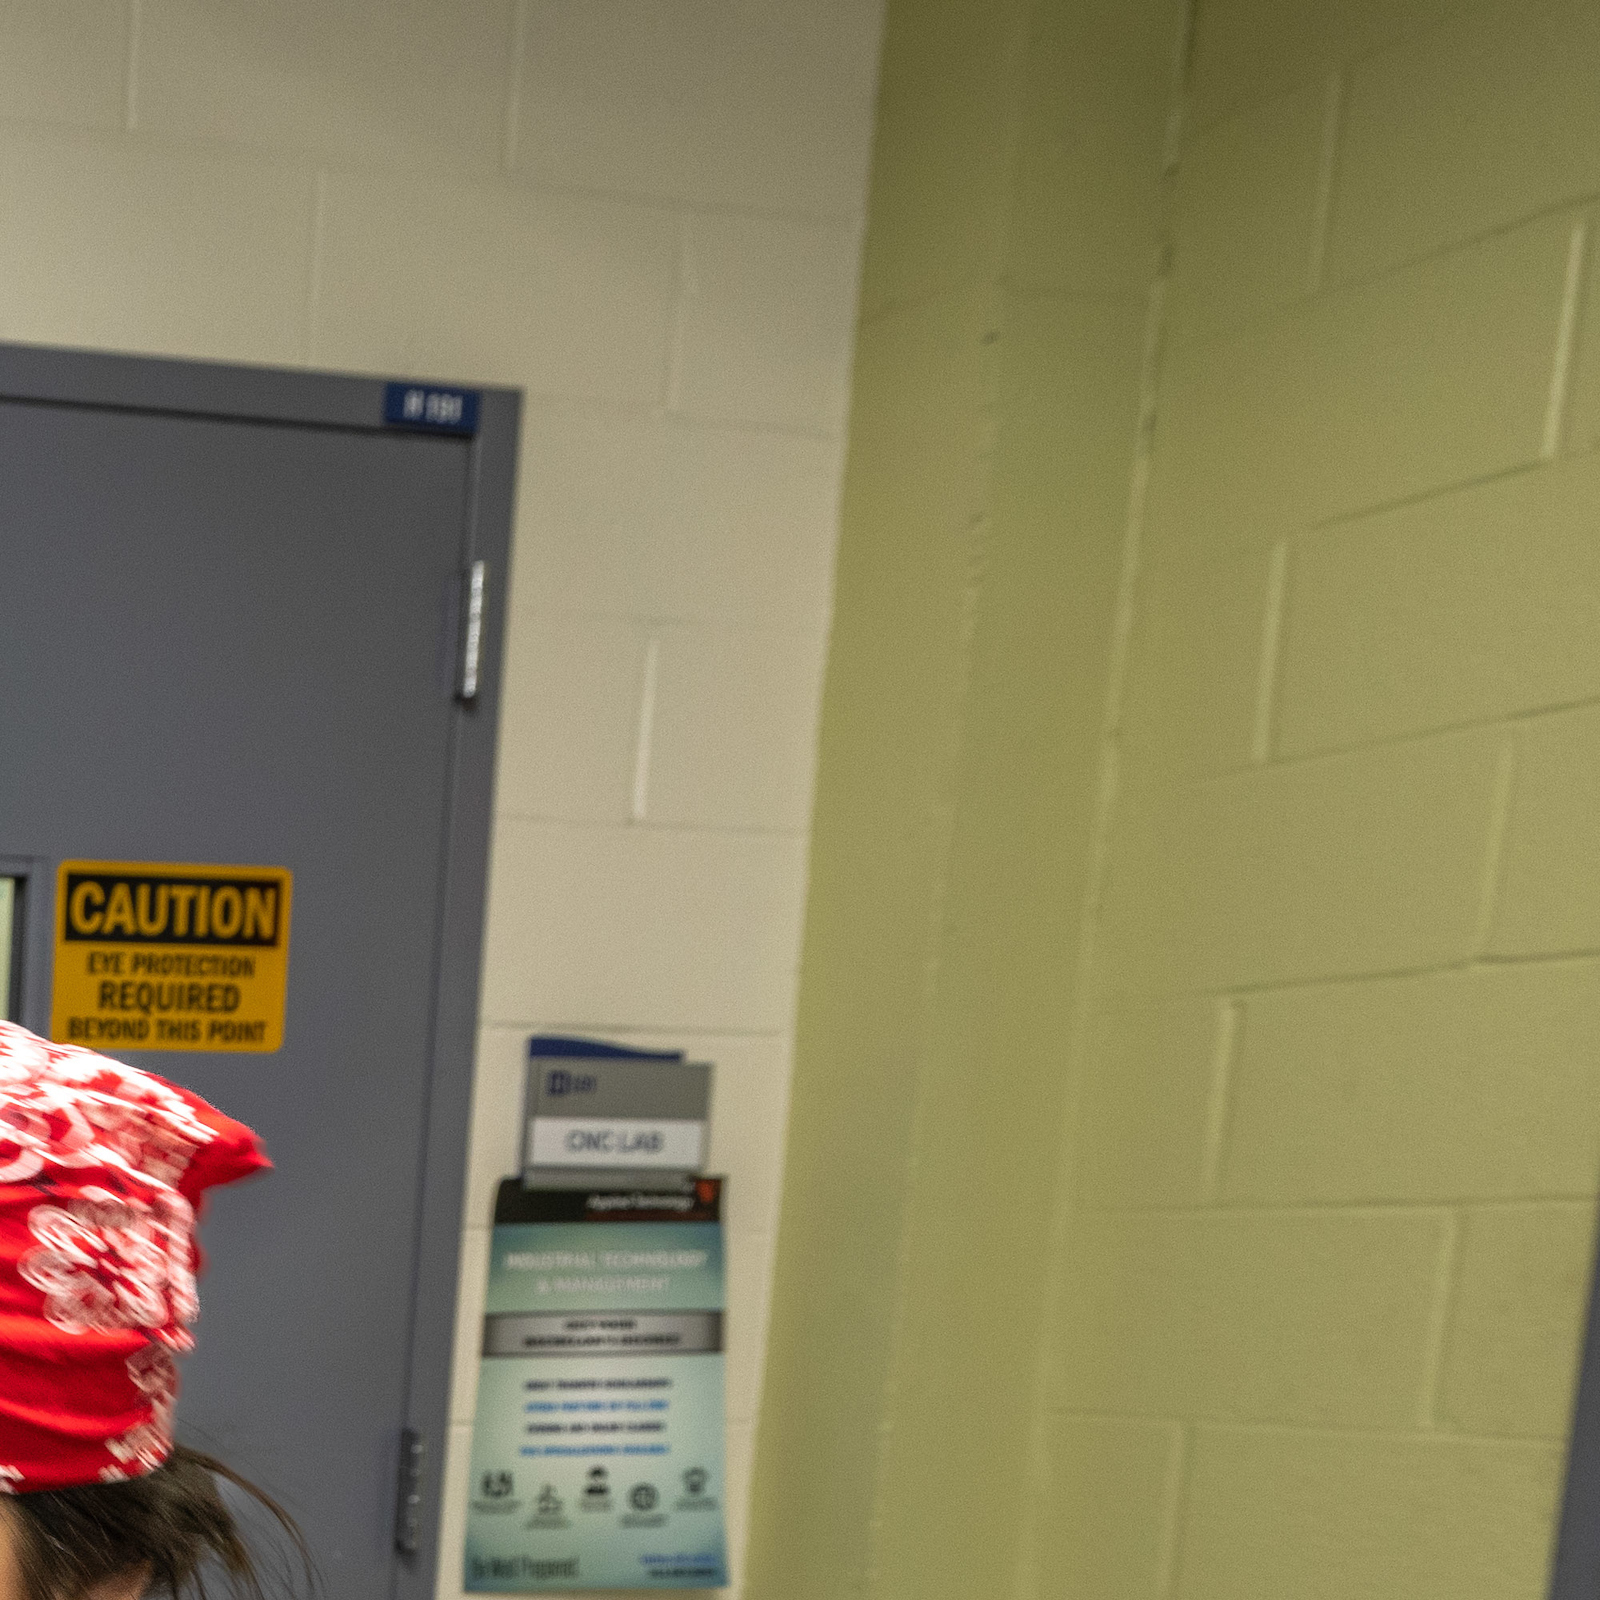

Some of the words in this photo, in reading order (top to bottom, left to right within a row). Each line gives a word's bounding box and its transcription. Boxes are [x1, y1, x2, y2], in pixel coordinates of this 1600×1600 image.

[69, 881, 277, 939] CAUTION
[87, 952, 123, 976] EYE
[131, 954, 255, 978] PROTECTION
[98, 980, 242, 1015] REQUIRED
[68, 1016, 150, 1042] BEYOND
[156, 1018, 202, 1042] THIS
[207, 1020, 267, 1044] POINT
[615, 1131, 664, 1153] LAB
